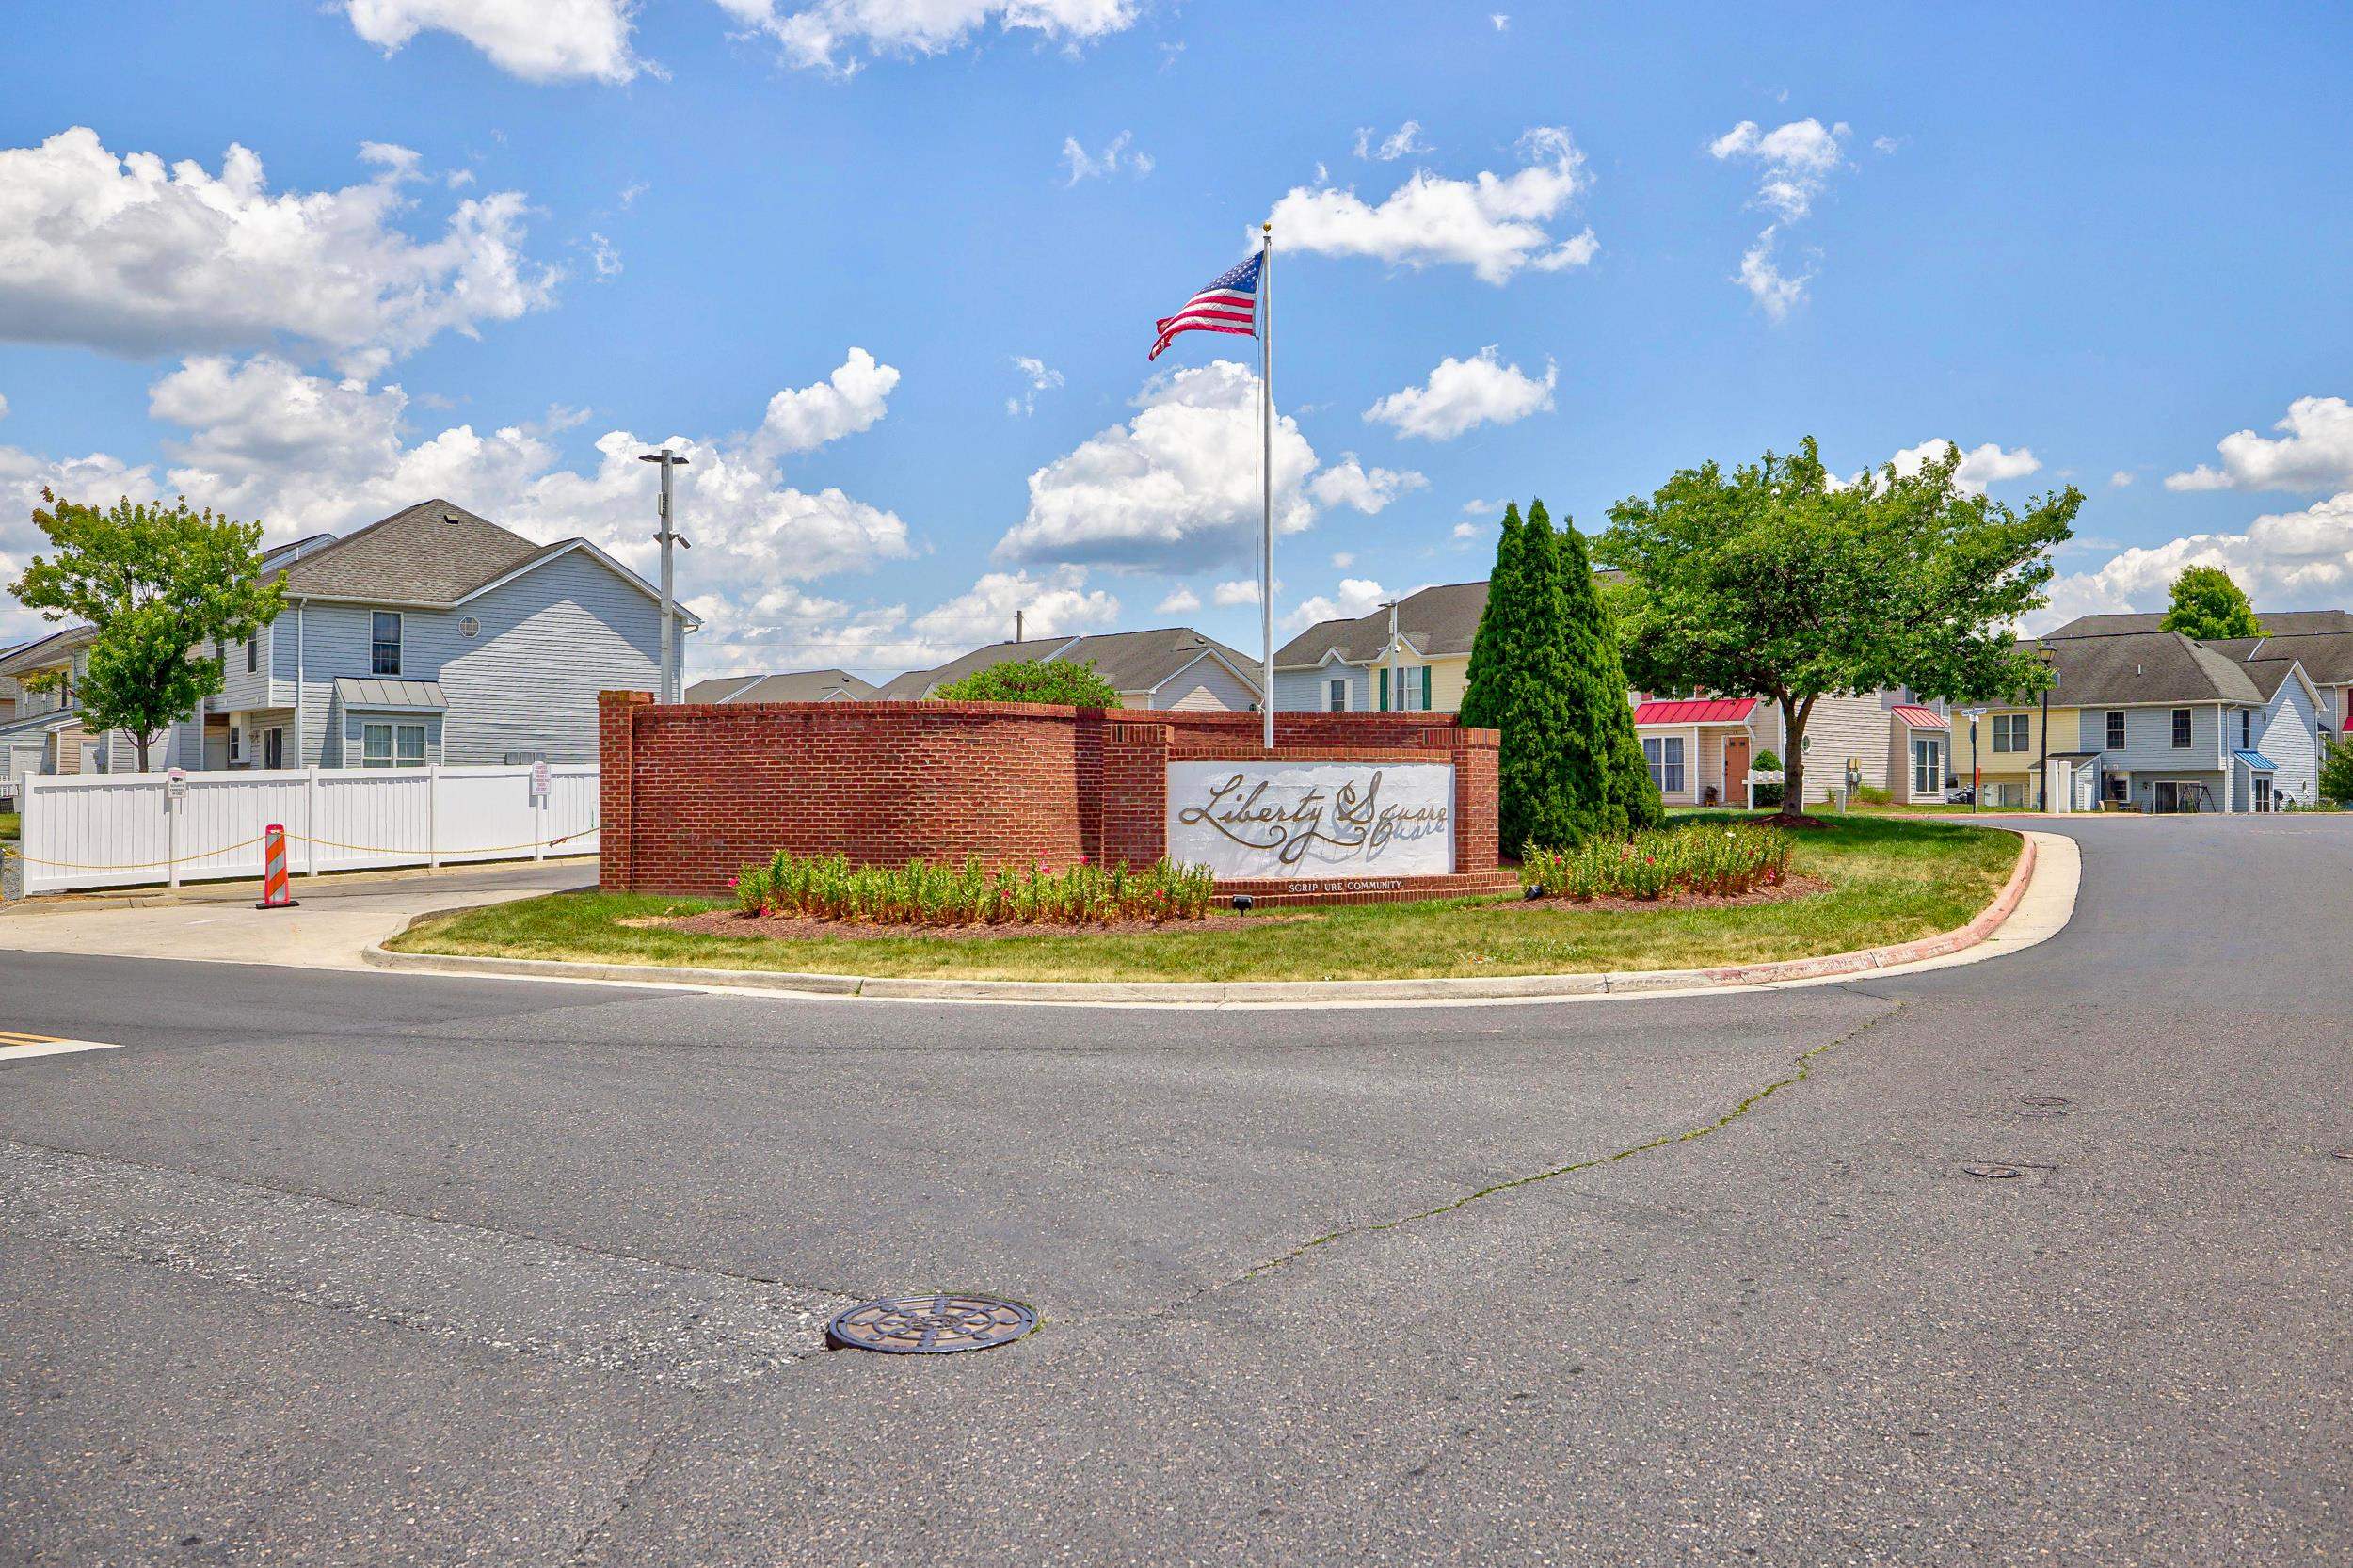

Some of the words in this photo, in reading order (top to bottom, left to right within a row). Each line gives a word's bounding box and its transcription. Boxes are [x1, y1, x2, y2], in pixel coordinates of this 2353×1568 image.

[1178, 774, 1366, 864] Liberty
[1337, 771, 1448, 847] Square
[1347, 880, 1401, 890] COMMUNITY
